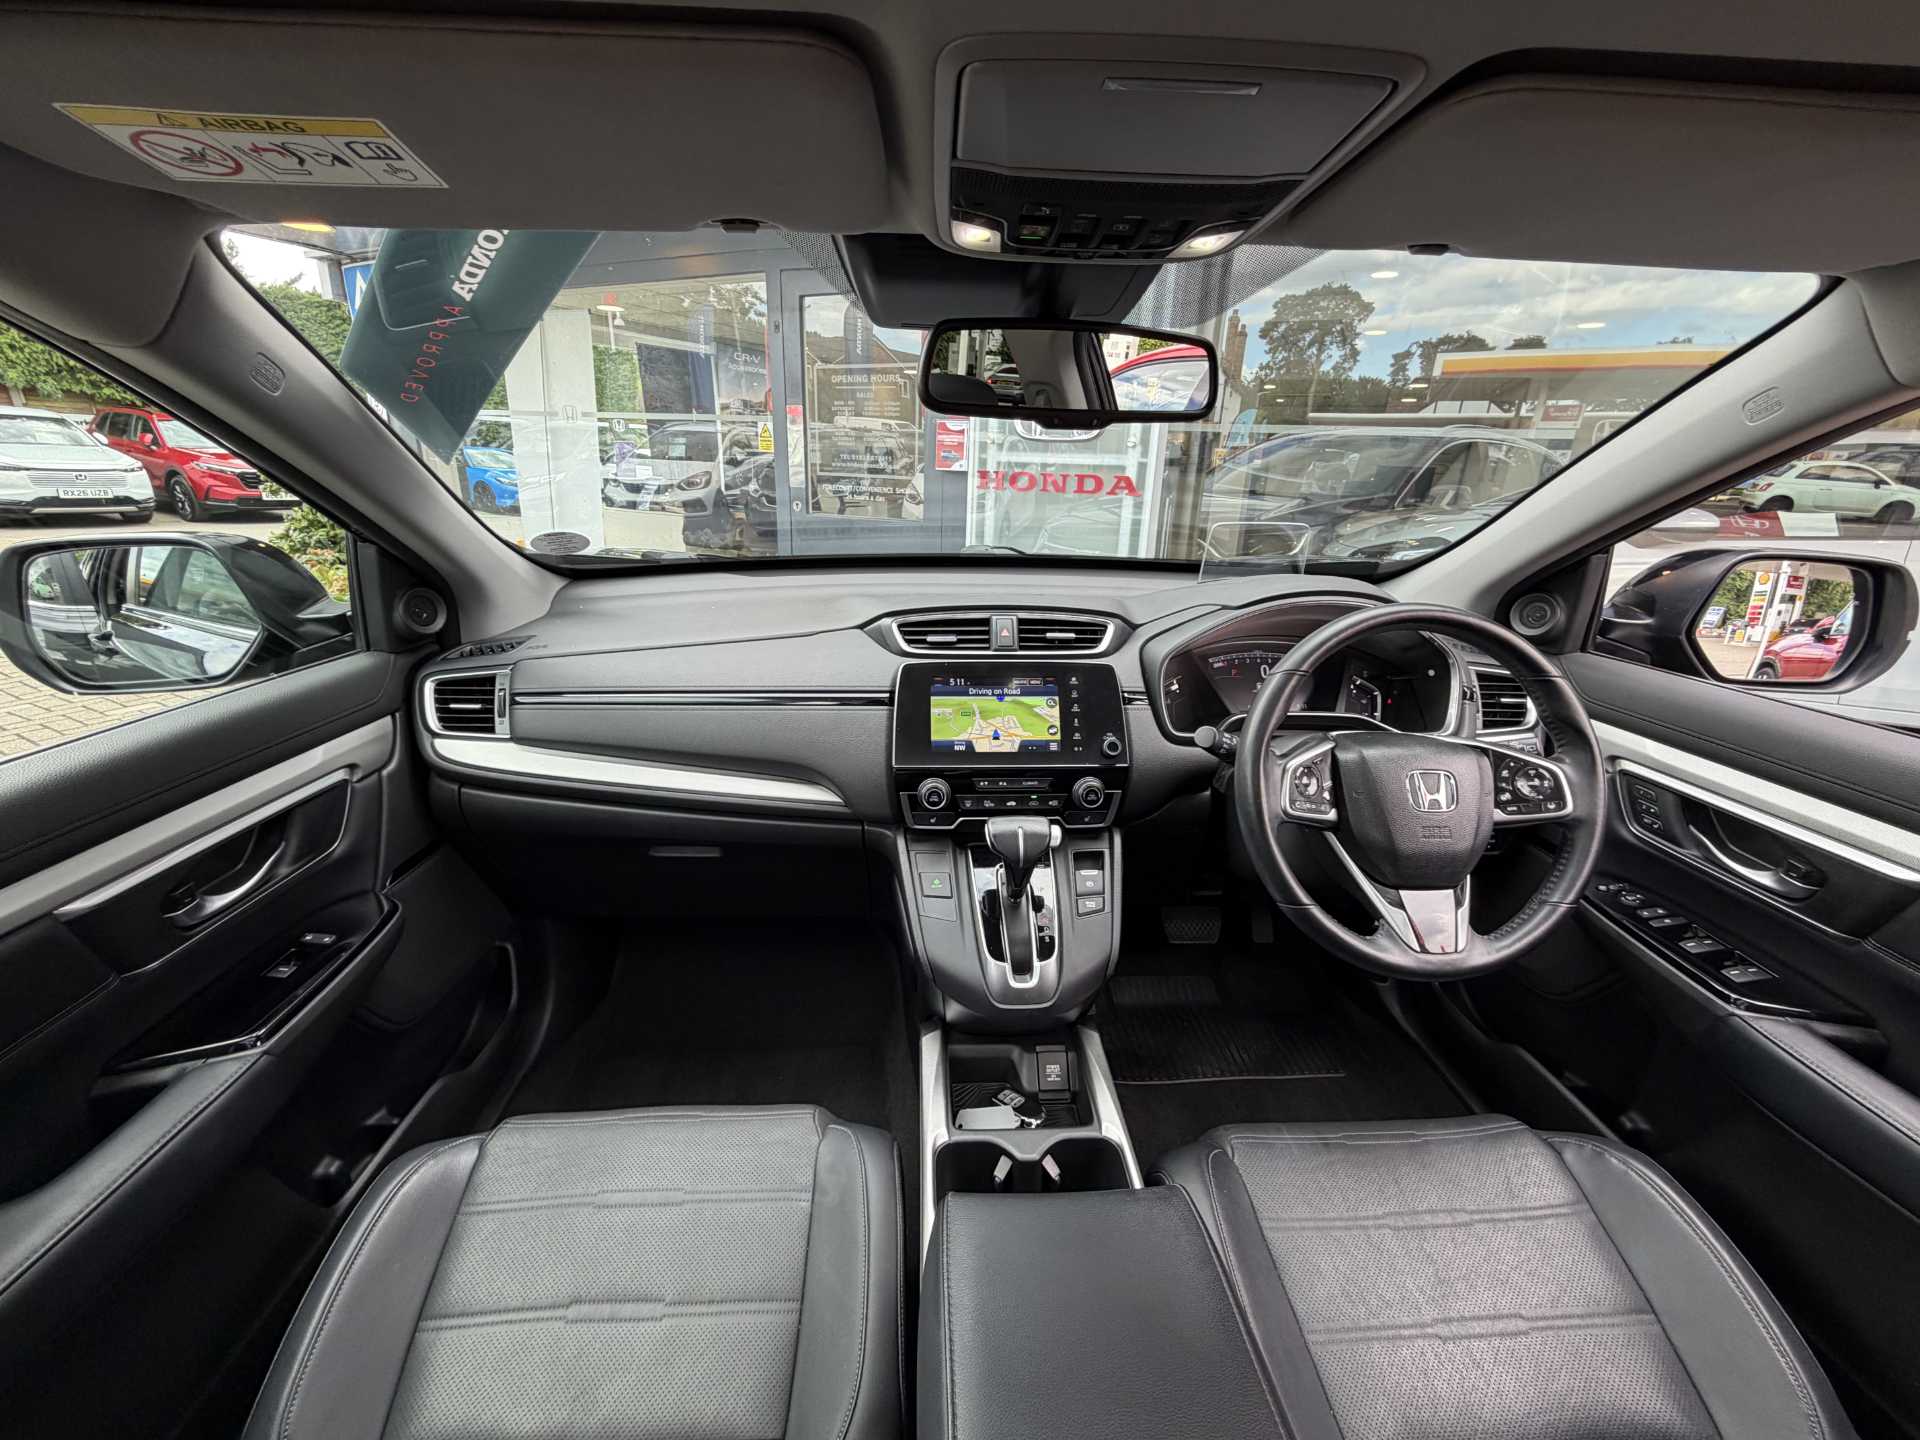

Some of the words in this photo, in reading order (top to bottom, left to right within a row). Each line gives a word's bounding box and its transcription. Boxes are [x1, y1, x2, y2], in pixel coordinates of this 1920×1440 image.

[197, 115, 307, 134] AIRBAG
[831, 374, 868, 383] OPENING
[870, 373, 901, 383] HOURS
[976, 470, 1142, 497] HONDA
[968, 687, 992, 696] Driving
[1003, 687, 1021, 695] Road
[954, 743, 966, 751] NW
